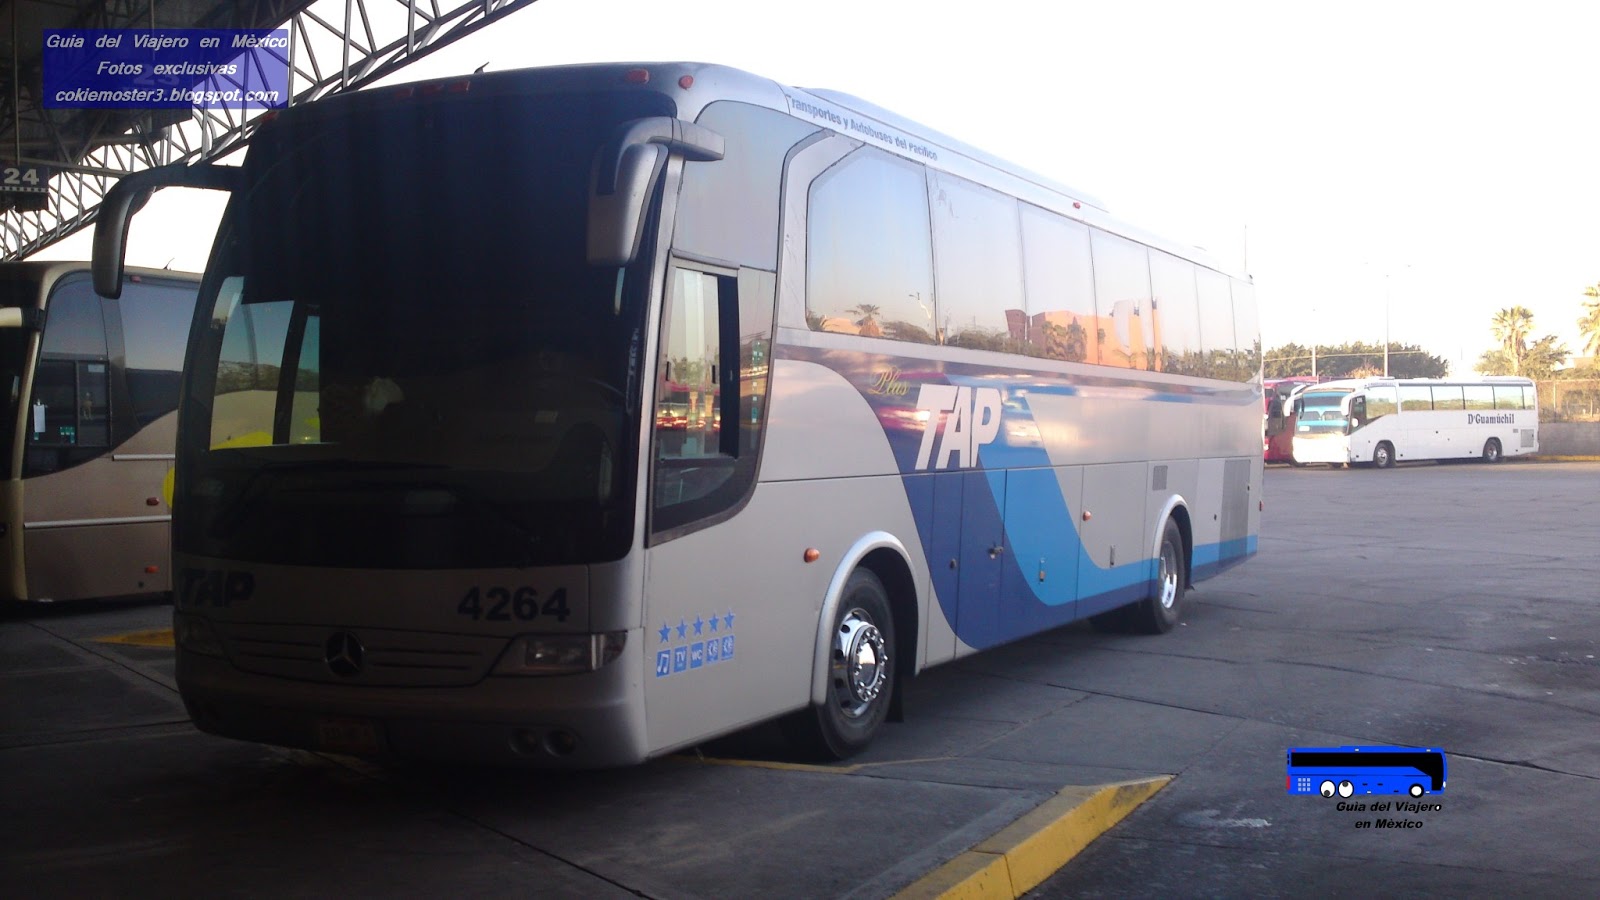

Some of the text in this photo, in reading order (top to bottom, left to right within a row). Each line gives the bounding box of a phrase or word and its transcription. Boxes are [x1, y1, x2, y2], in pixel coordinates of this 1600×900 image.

[843, 117, 849, 131] y
[850, 118, 893, 144] Autobuses
[3, 167, 40, 186] 24
[869, 365, 909, 396] Plus
[915, 383, 1002, 471] TAP
[180, 567, 256, 609] TAP
[457, 586, 571, 622] 4264
